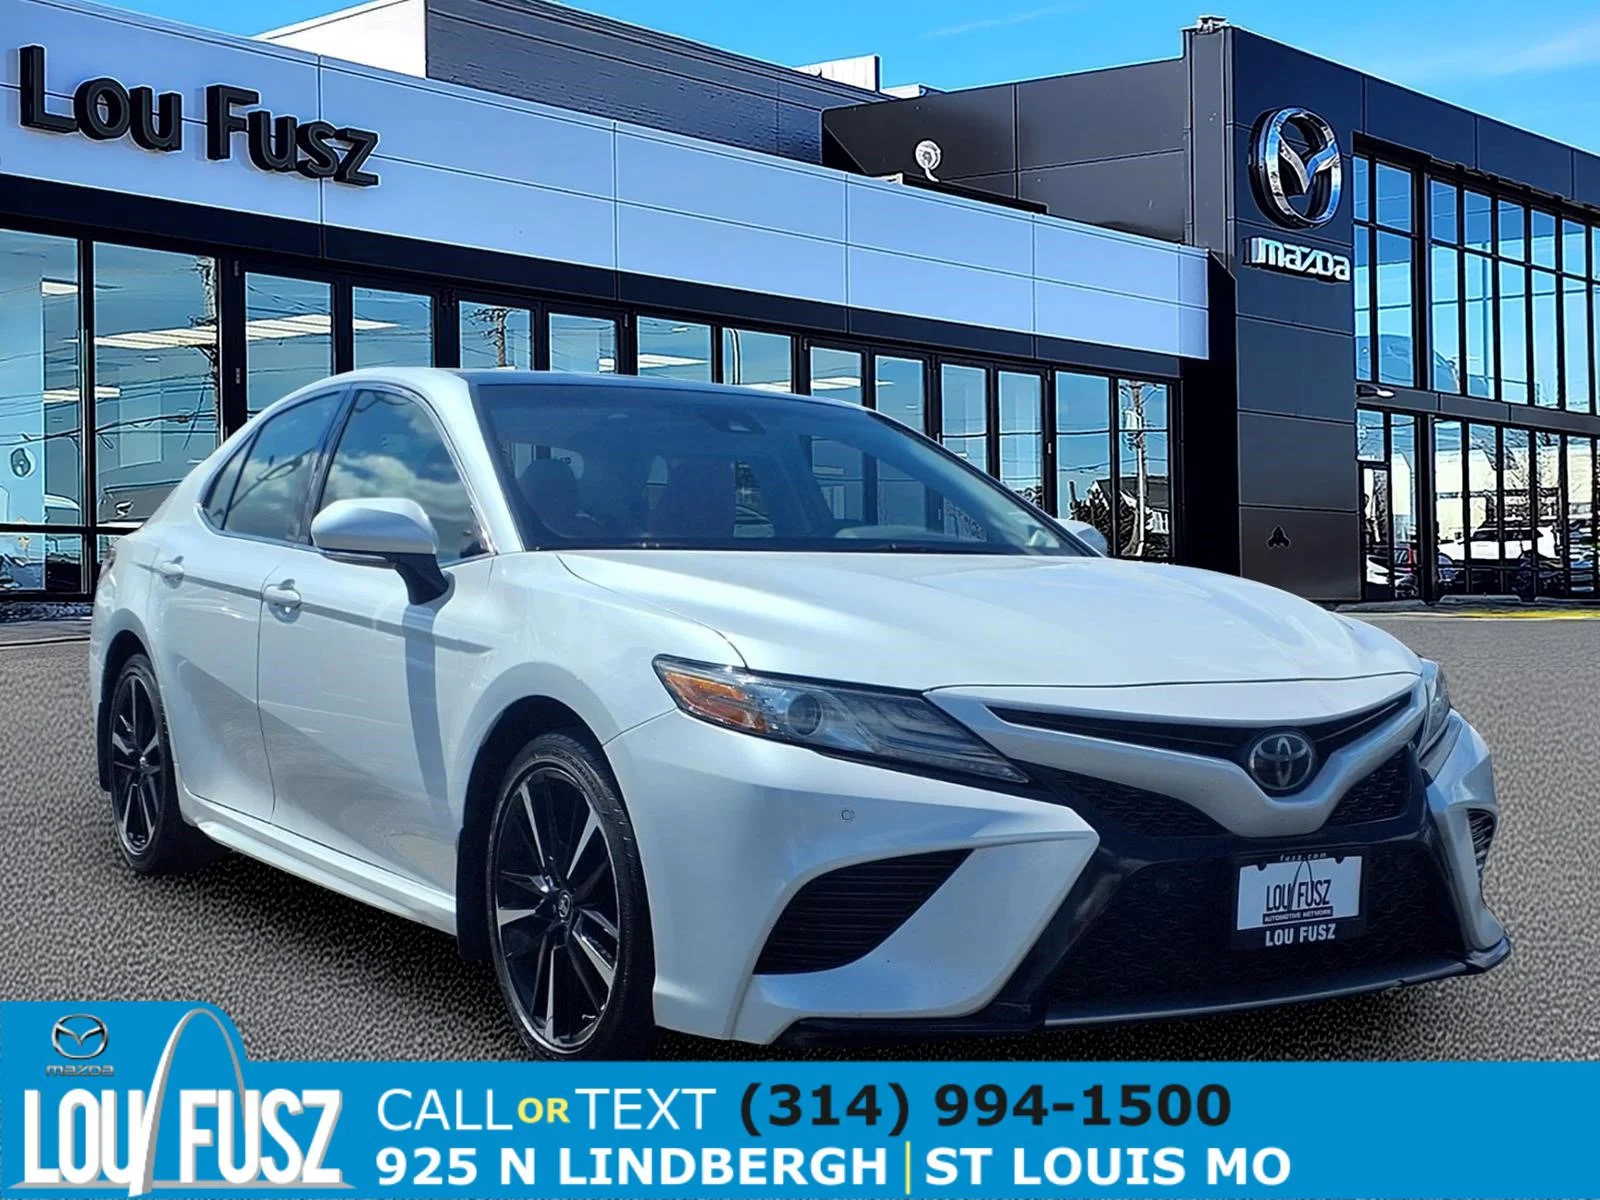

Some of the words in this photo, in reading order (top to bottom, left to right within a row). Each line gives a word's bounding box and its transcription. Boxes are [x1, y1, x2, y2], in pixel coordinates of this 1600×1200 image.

[18, 45, 183, 153] Lou
[206, 84, 380, 188] Fusz
[1265, 883, 1291, 913] LOU
[1297, 879, 1332, 908] FUSZ
[1265, 928, 1294, 947] LOU
[1299, 923, 1337, 943] FUSZ
